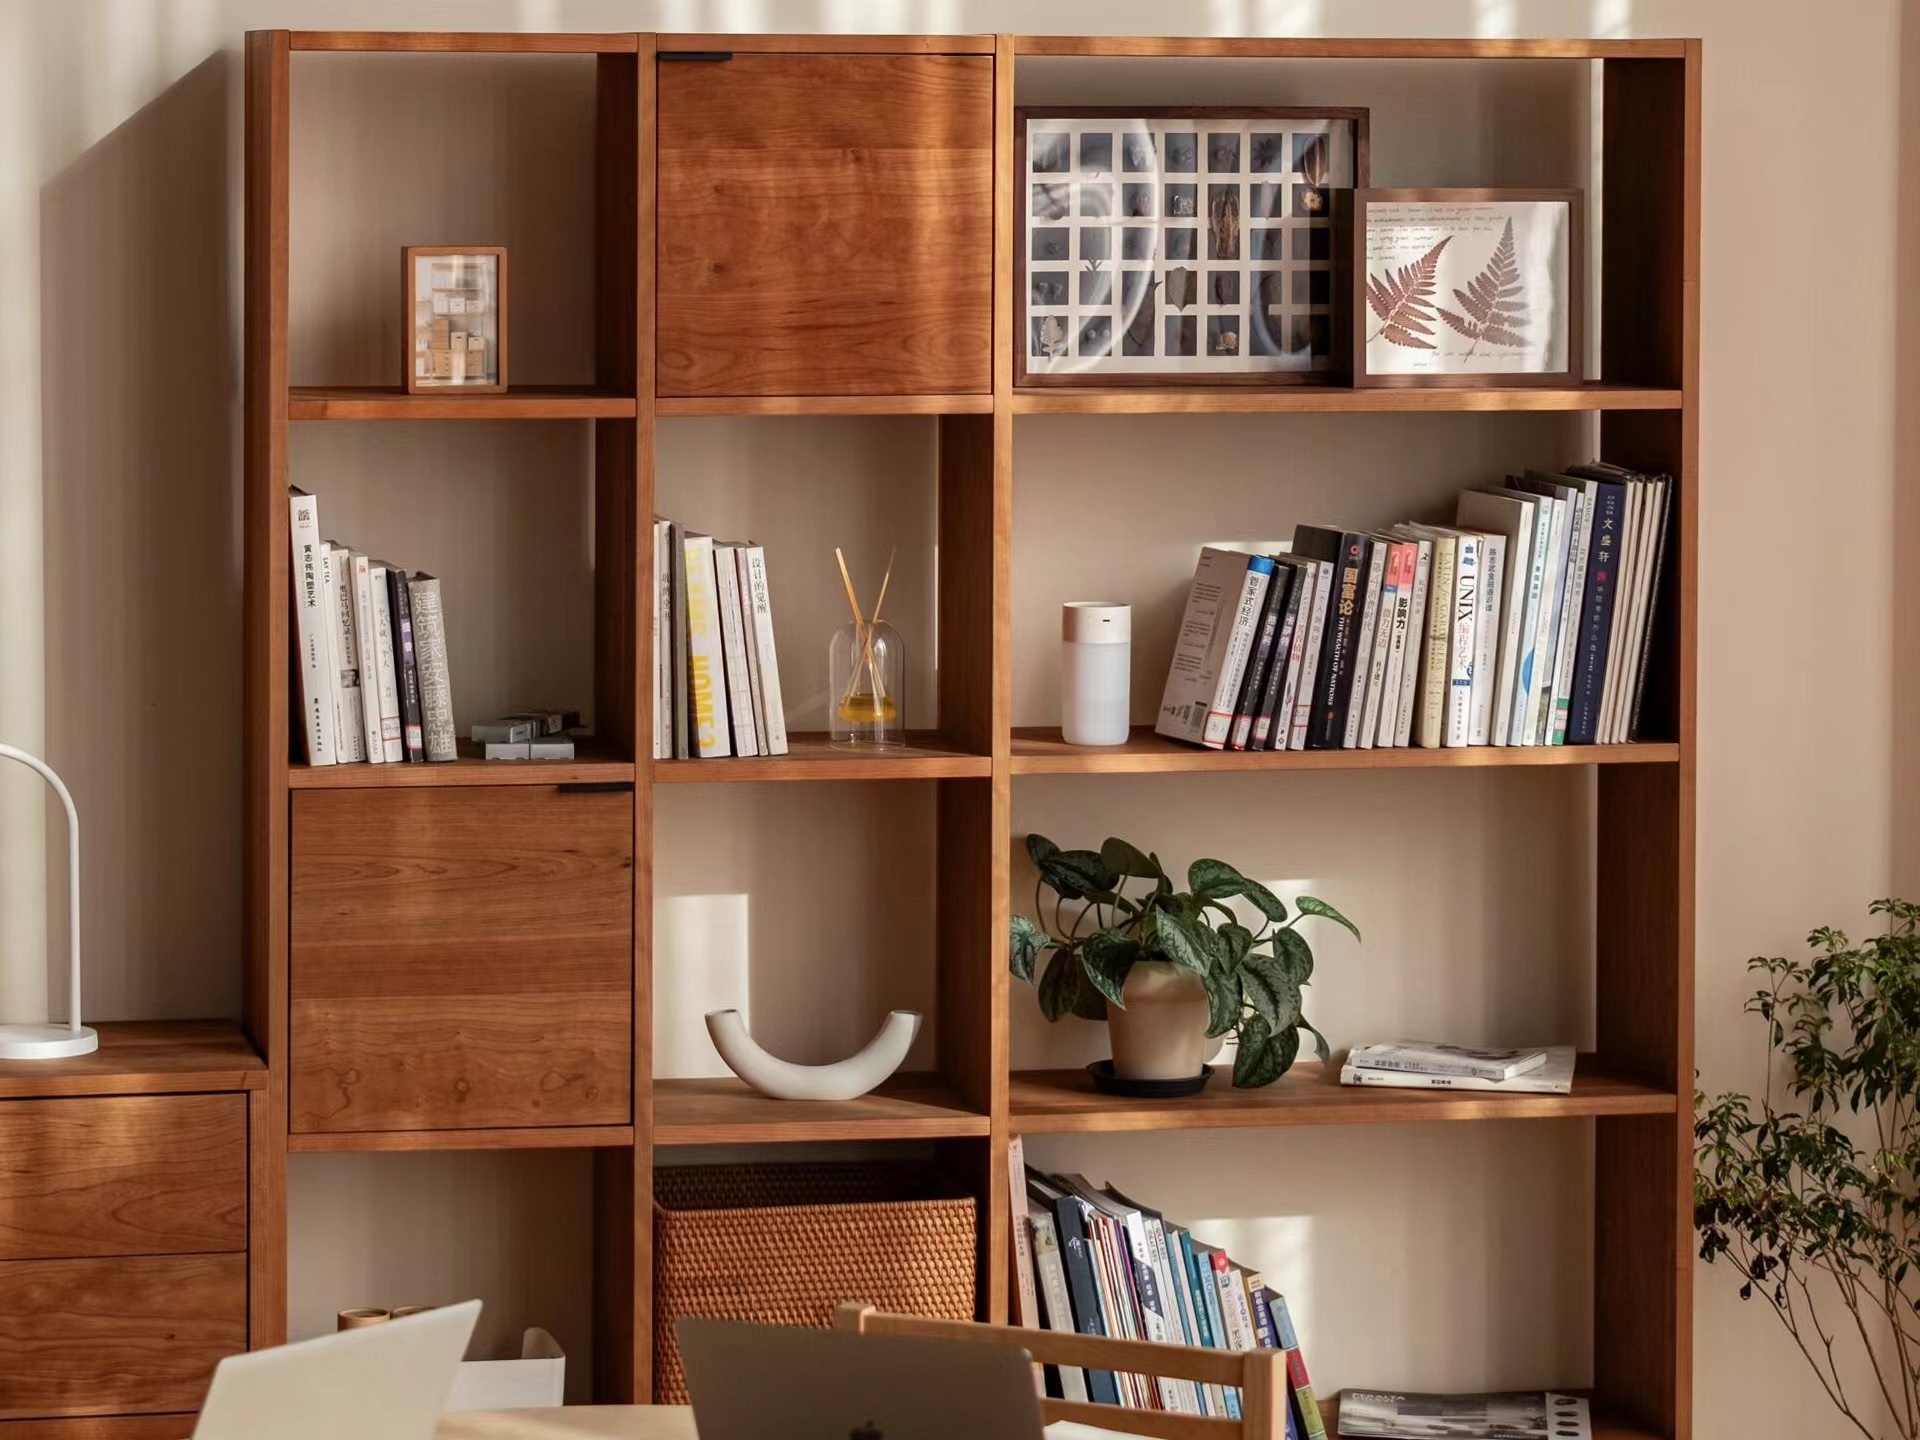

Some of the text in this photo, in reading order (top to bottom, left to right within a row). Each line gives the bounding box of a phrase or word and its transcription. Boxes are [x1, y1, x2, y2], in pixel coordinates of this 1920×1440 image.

[751, 557, 768, 614] 设计的觉醒
[1338, 567, 1359, 617] 国富论
[1457, 575, 1475, 621] UNIX
[1396, 597, 1409, 631] 影响力
[1332, 631, 1342, 661] WEALTH
[1455, 622, 1472, 669] 编程艺术
[413, 591, 452, 753] 建筑家安藤忠雄
[1327, 672, 1337, 705] NATIONS
